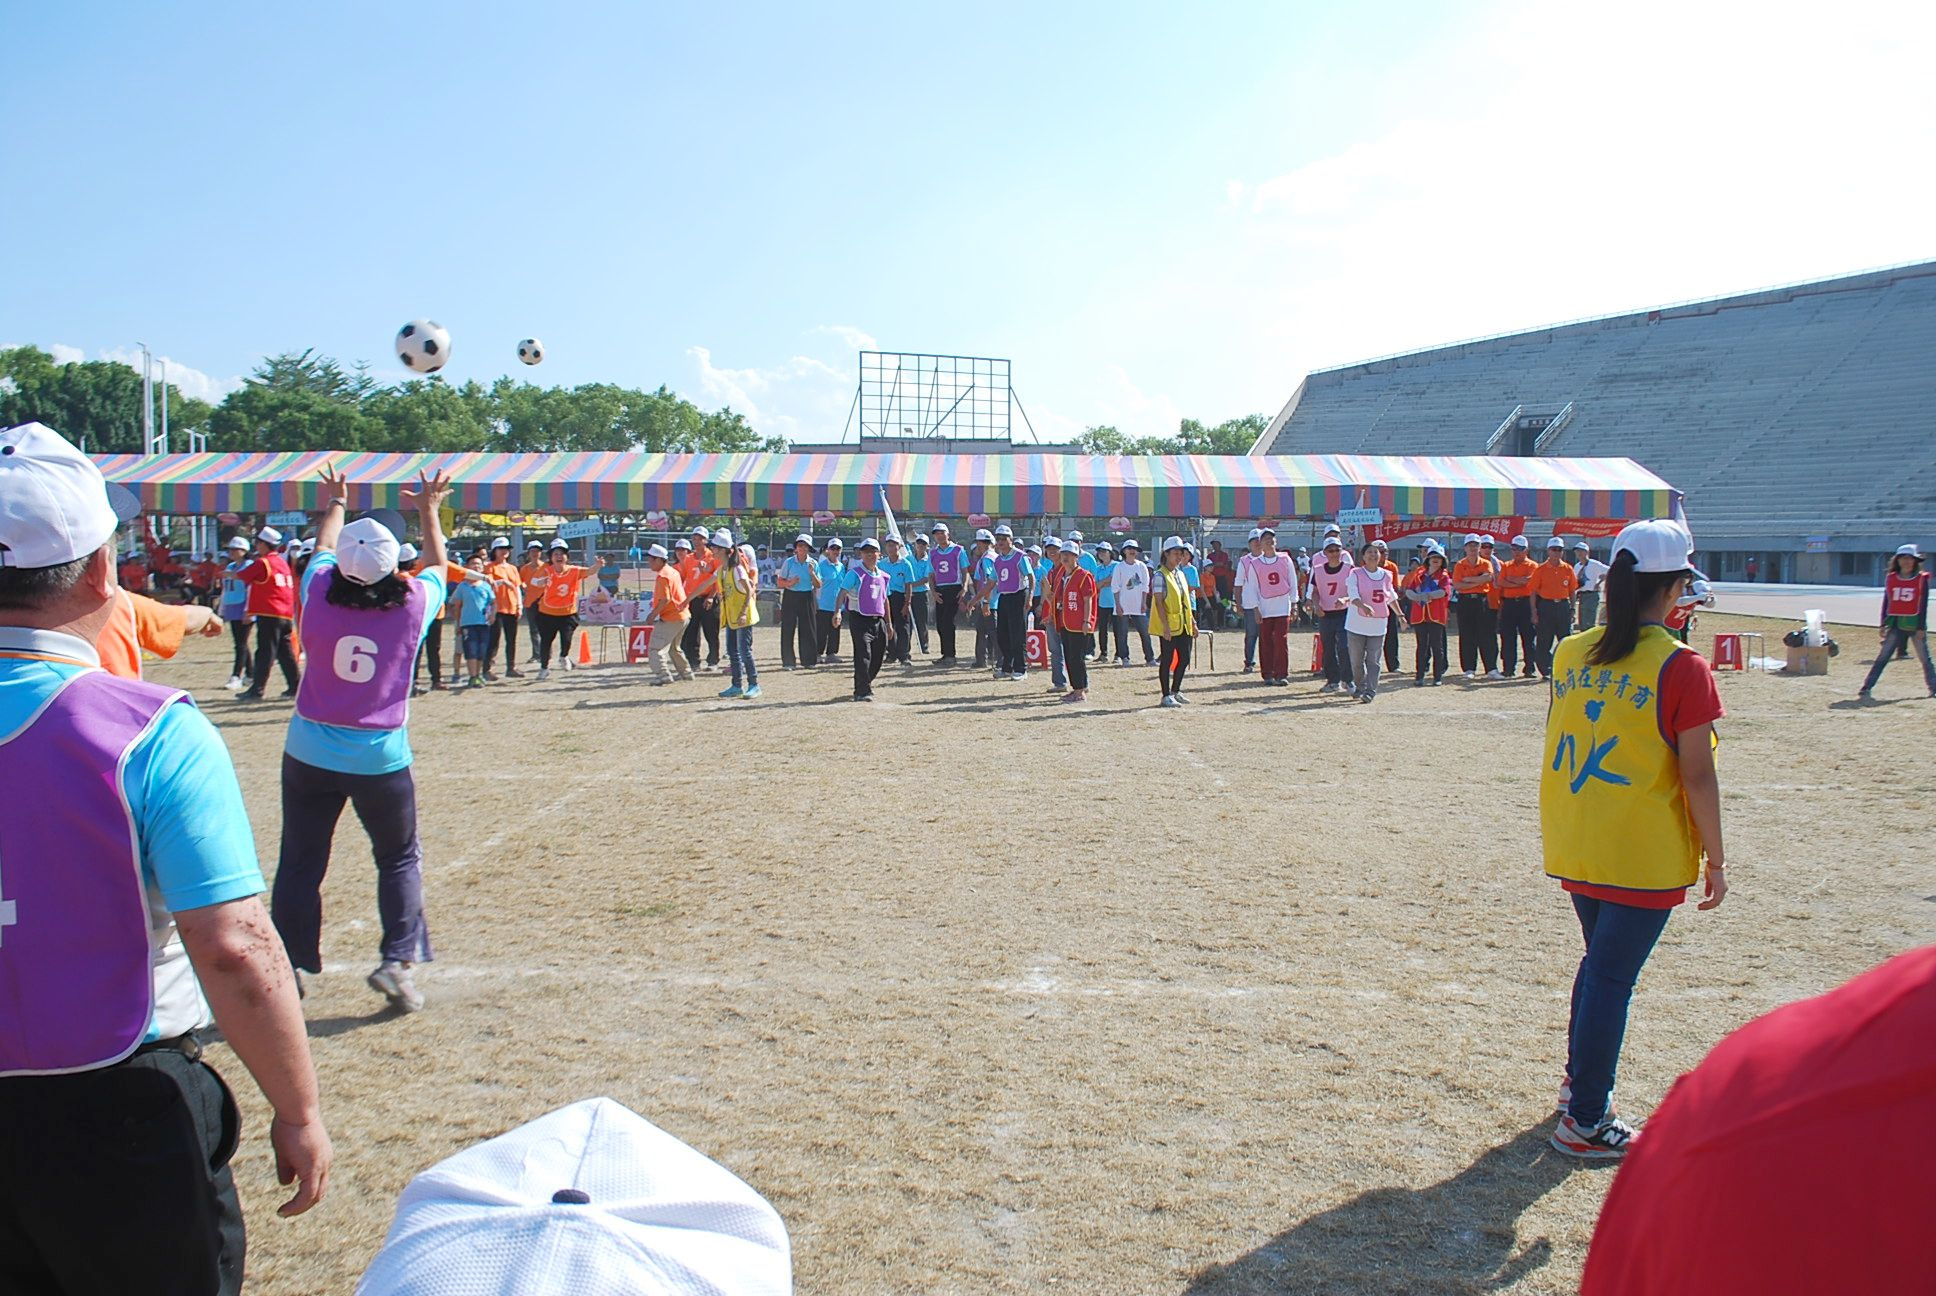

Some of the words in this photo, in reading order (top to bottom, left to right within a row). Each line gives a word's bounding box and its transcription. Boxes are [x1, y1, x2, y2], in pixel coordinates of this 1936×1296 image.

[939, 560, 949, 573] 3
[1000, 568, 1009, 581] 9
[1268, 572, 1280, 585] 9
[557, 584, 569, 597] 3
[870, 584, 881, 599] 7
[1327, 582, 1338, 596] 7
[1371, 589, 1384, 603] 5
[1892, 587, 1916, 602] 15
[632, 630, 647, 654] 4
[1027, 635, 1040, 660] 3
[1721, 637, 1732, 661] 1
[333, 635, 378, 683] 6
